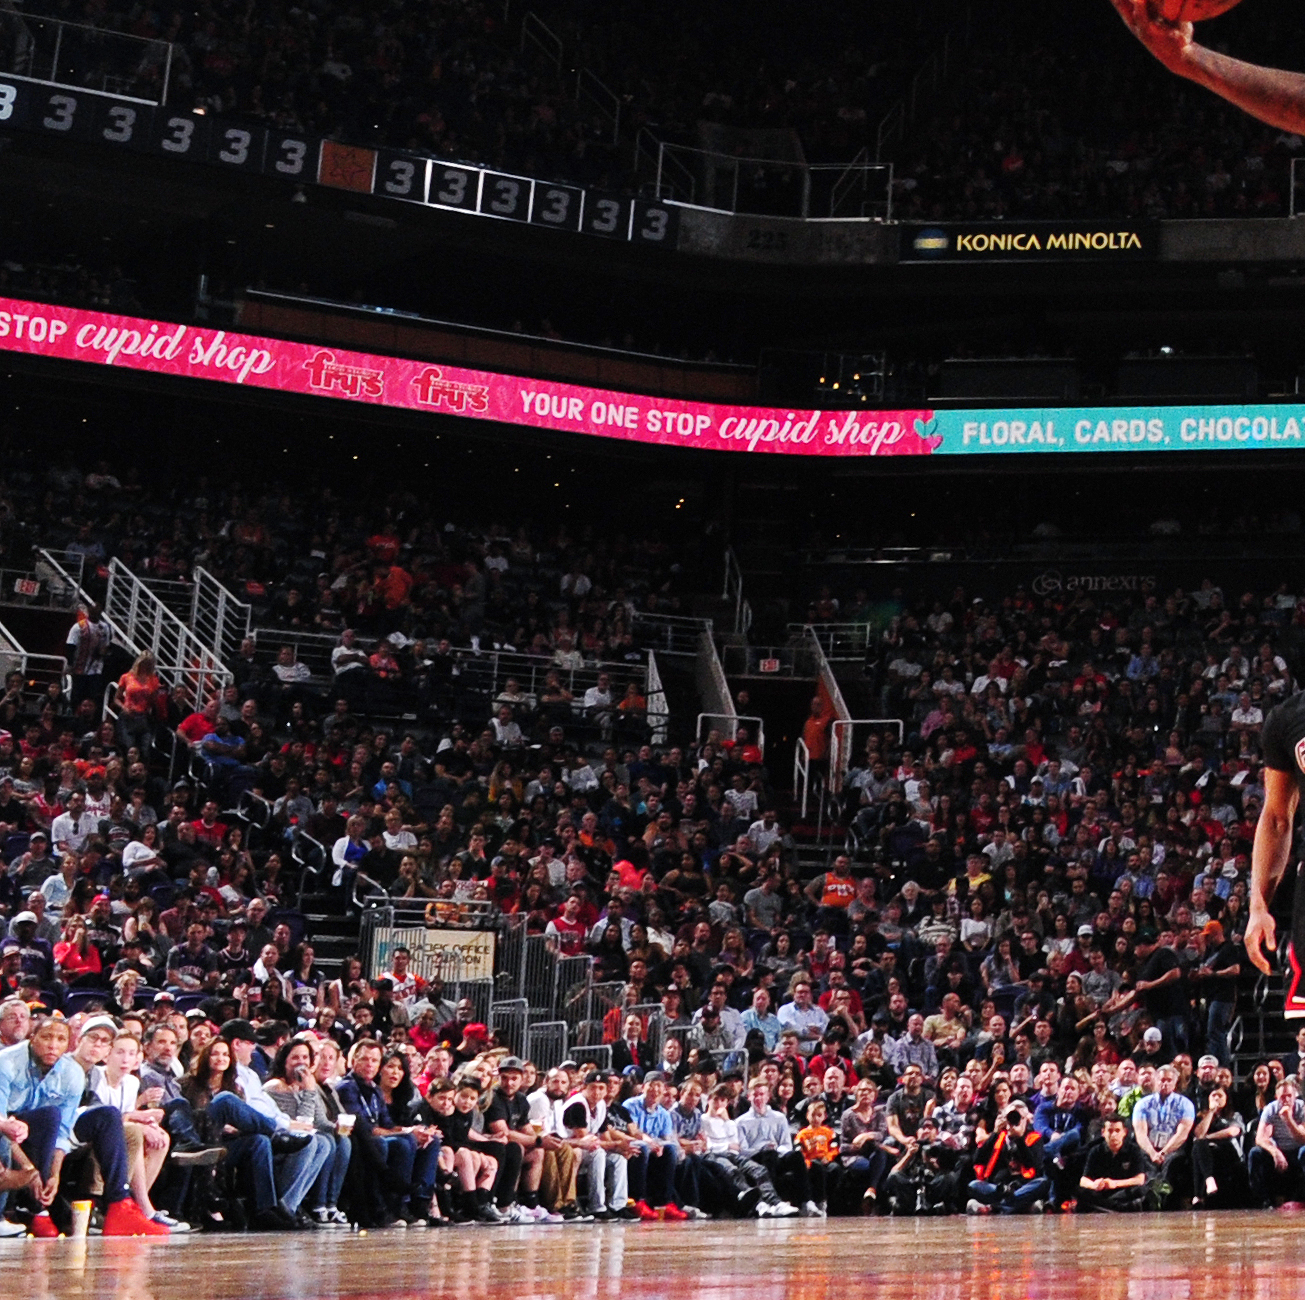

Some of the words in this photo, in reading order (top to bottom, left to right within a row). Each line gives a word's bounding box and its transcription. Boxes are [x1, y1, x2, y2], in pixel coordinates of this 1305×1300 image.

[43, 94, 77, 131] 3
[103, 106, 137, 142] 3
[161, 117, 195, 153] 3
[219, 128, 251, 165] 3
[275, 139, 307, 174] 3
[385, 160, 415, 195] 3
[438, 170, 468, 204] 3
[490, 180, 519, 214] 3
[541, 189, 570, 223] 3
[592, 199, 620, 232] 3
[641, 208, 669, 241] 3
[956, 233, 1043, 252] KONICA
[1046, 231, 1142, 250] MINOLTA
[0, 311, 68, 344] STOP
[76, 324, 188, 365] cupid
[189, 330, 276, 384] shop
[520, 390, 583, 421] YOUR
[591, 401, 639, 430] ONE
[647, 410, 712, 437] STOP
[719, 411, 822, 452] cupid
[825, 411, 906, 456] shop
[962, 420, 1065, 447] FLORAL,
[1074, 418, 1170, 445] CARDS,
[452, 944, 491, 955] OFFICE
